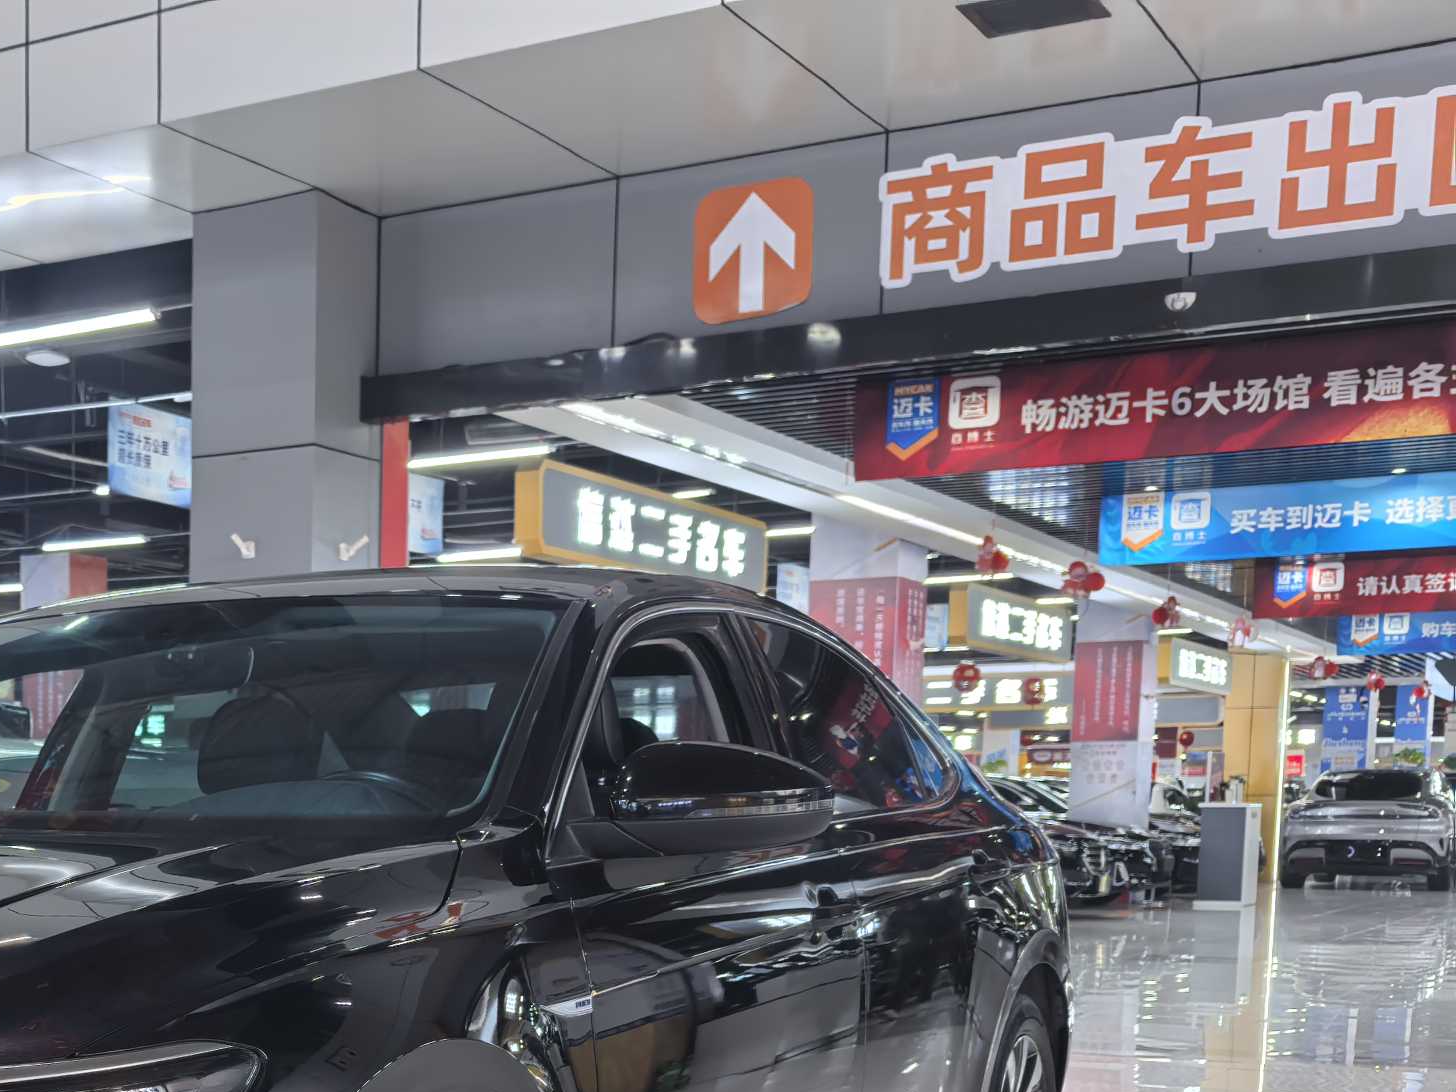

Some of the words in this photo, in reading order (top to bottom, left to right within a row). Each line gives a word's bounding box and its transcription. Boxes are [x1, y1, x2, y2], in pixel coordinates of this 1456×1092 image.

[884, 93, 1456, 281] 商品车出
[893, 396, 934, 418] 迈卡
[1021, 373, 1311, 434] 畅游迈卡6大场馆
[1229, 500, 1373, 535] 买车到迈卡
